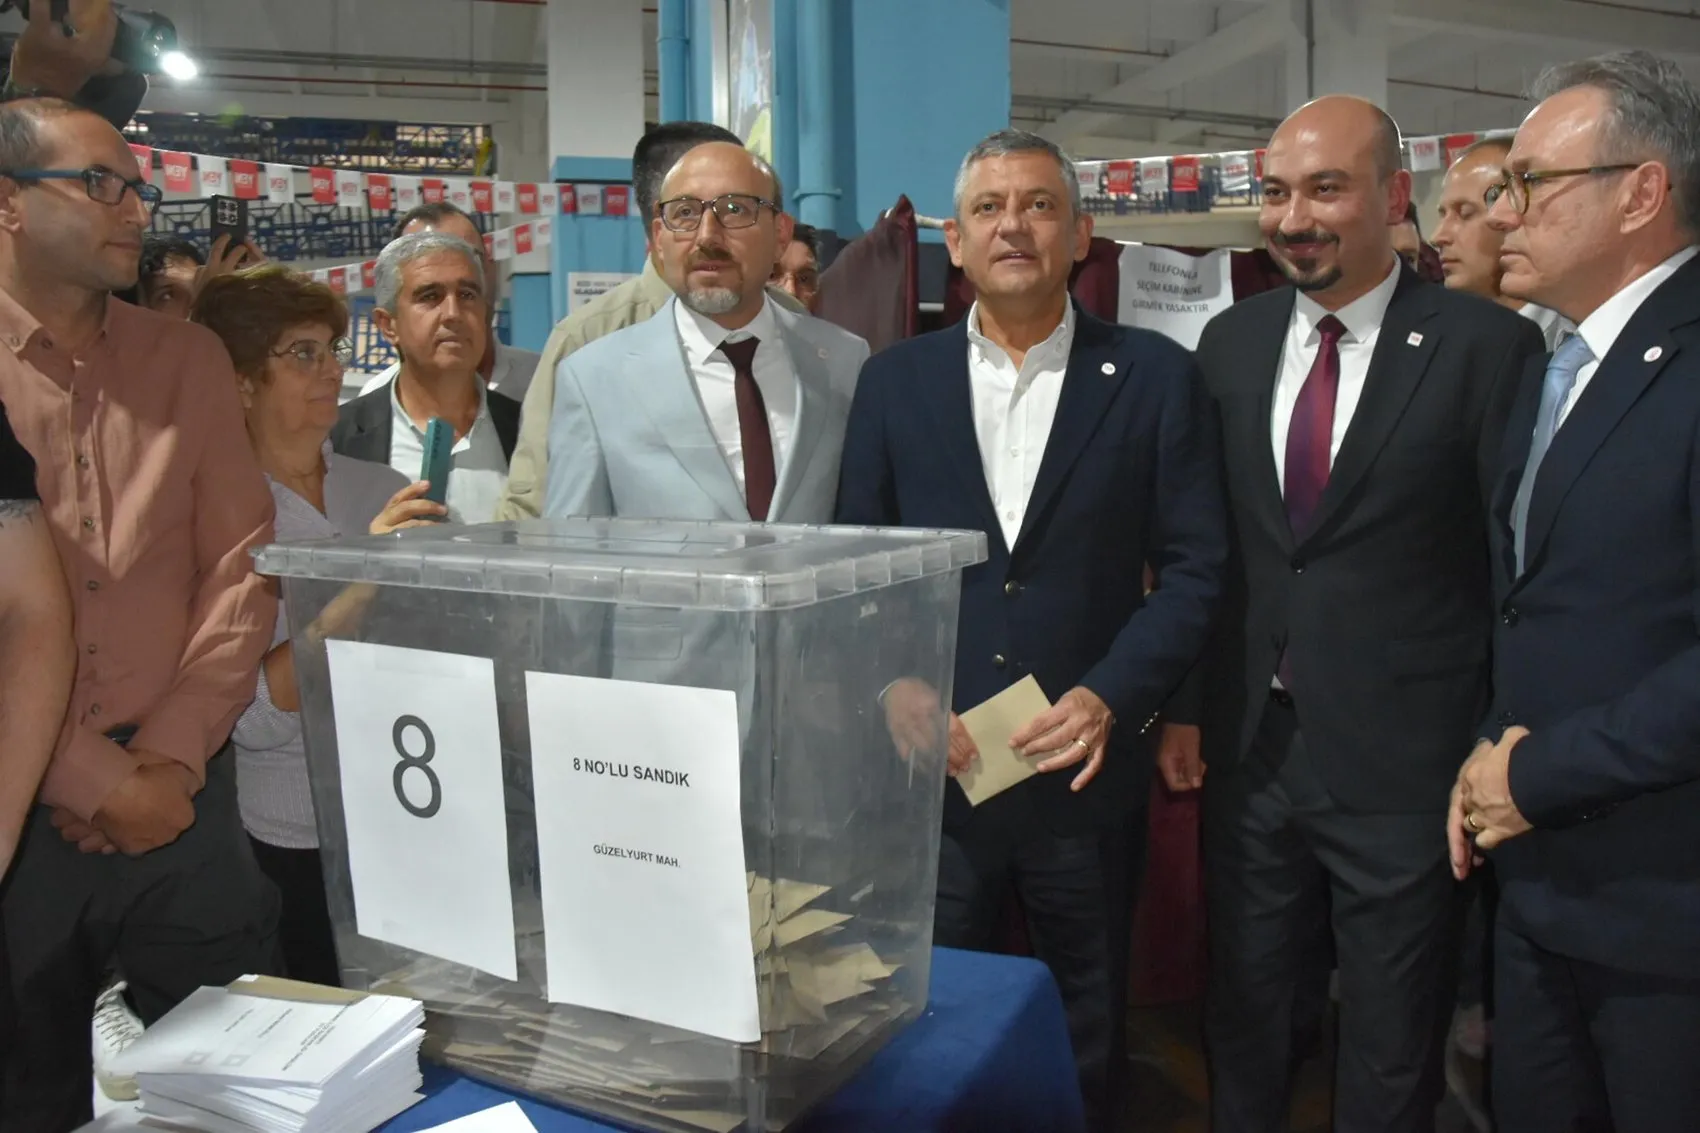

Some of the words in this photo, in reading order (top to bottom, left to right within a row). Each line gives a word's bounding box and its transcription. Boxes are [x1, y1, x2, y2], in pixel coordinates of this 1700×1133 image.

[392, 714, 442, 819] 8
[573, 757, 581, 771] 8
[633, 765, 690, 788] SANDIK
[593, 843, 653, 862] GÜZELYURT
[656, 854, 681, 868] MAH.
